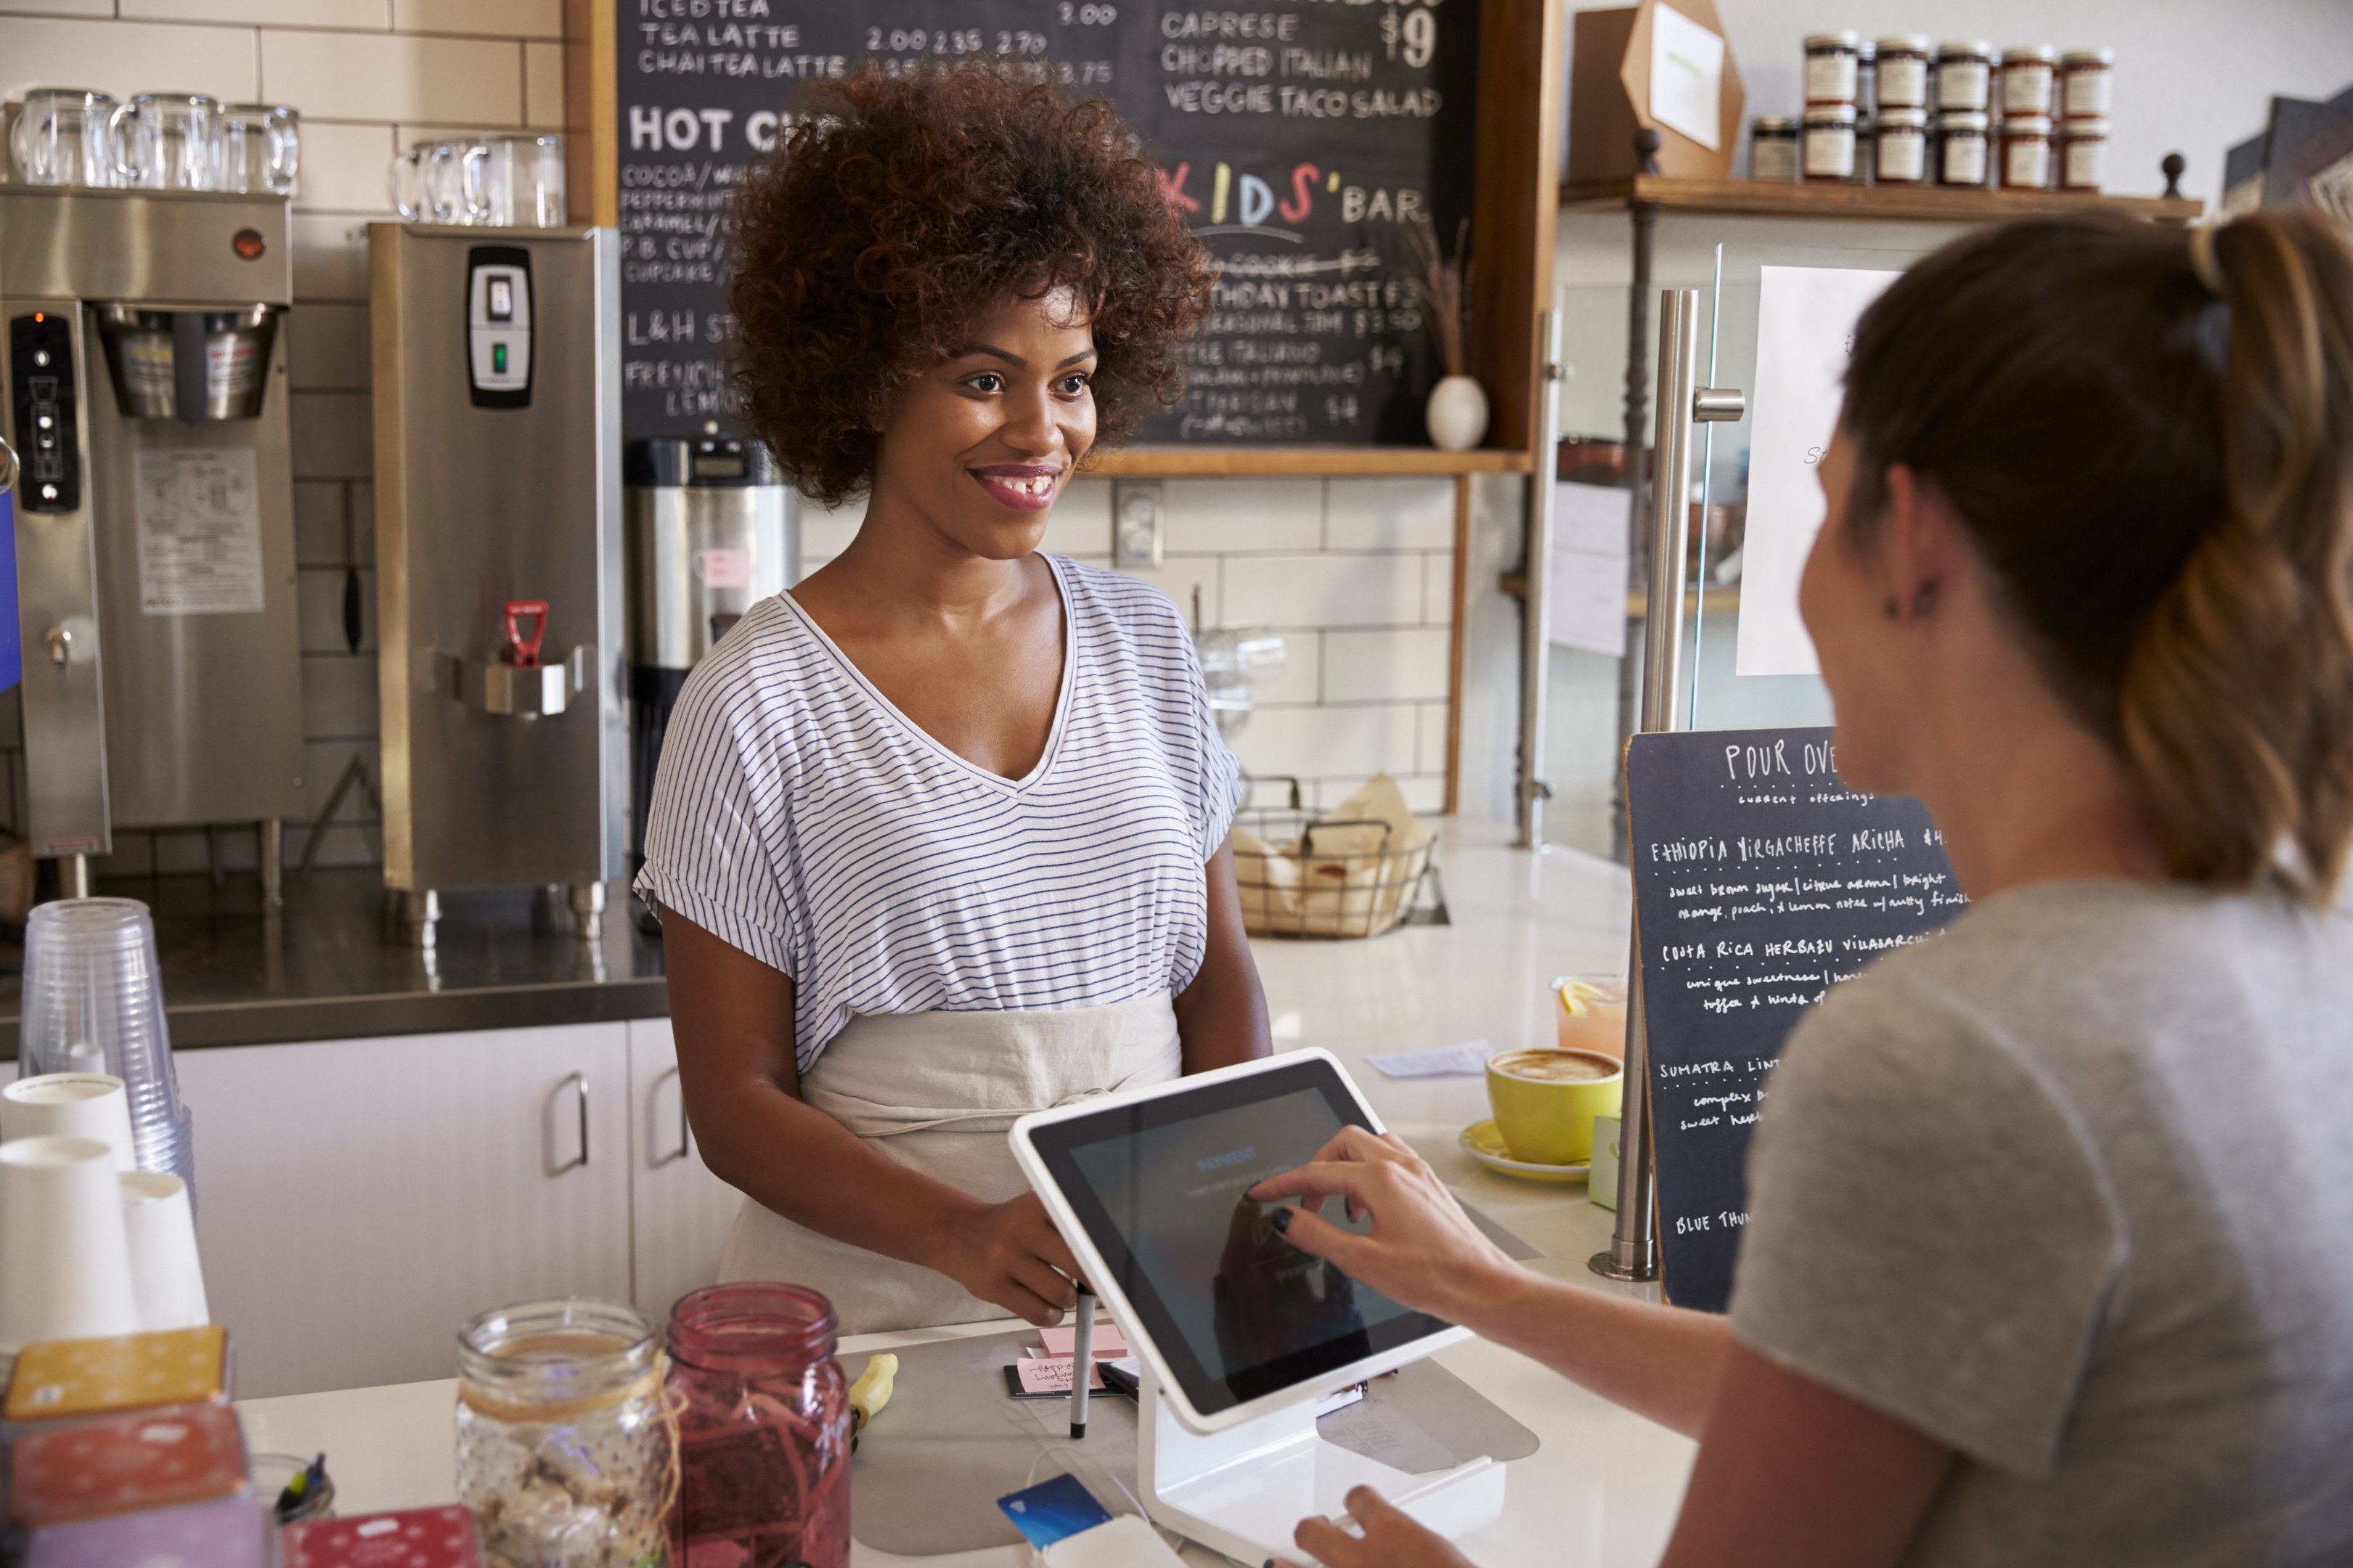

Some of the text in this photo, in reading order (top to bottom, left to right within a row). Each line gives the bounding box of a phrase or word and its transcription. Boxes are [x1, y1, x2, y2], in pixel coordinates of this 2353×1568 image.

[638, 22, 799, 49] TEA LATTE
[865, 25, 928, 52] 2.00
[1162, 11, 1300, 41] CAPRESE
[1379, 4, 1438, 68] $9
[638, 49, 705, 75] CHAI
[763, 52, 847, 78] LATTE
[1162, 43, 1373, 83] CHOPPED ITALIAN
[1165, 81, 1443, 119] VEGGIE TACO SALAD
[629, 105, 734, 152] HOT
[1342, 184, 1427, 224] BAR
[1294, 281, 1381, 311] TOAST
[1803, 446, 1828, 465] St
[1725, 738, 1838, 780] POUR OVE
[1738, 791, 1875, 807] current offerings
[1669, 883, 1703, 899] sweet
[1710, 883, 1750, 896] brown
[1902, 873, 1947, 890] bright
[1788, 901, 1832, 912] lemon
[1836, 897, 1868, 909] notes
[1889, 895, 1925, 916] nutty
[1716, 940, 1754, 959] RICA
[1764, 939, 1833, 957] HERBAZU
[1687, 977, 1741, 992] unique
[1747, 972, 1822, 987] sweetness
[1833, 971, 1868, 984] hone
[1703, 997, 1742, 1014] toffee
[1768, 992, 1810, 1006] hints
[1814, 989, 1826, 1007] of
[1660, 1057, 1782, 1078] SUMATRA LINT
[1693, 1091, 1753, 1113] complex
[1680, 1115, 1721, 1131] sweet
[1676, 1209, 1754, 1235] BLUE THUN
